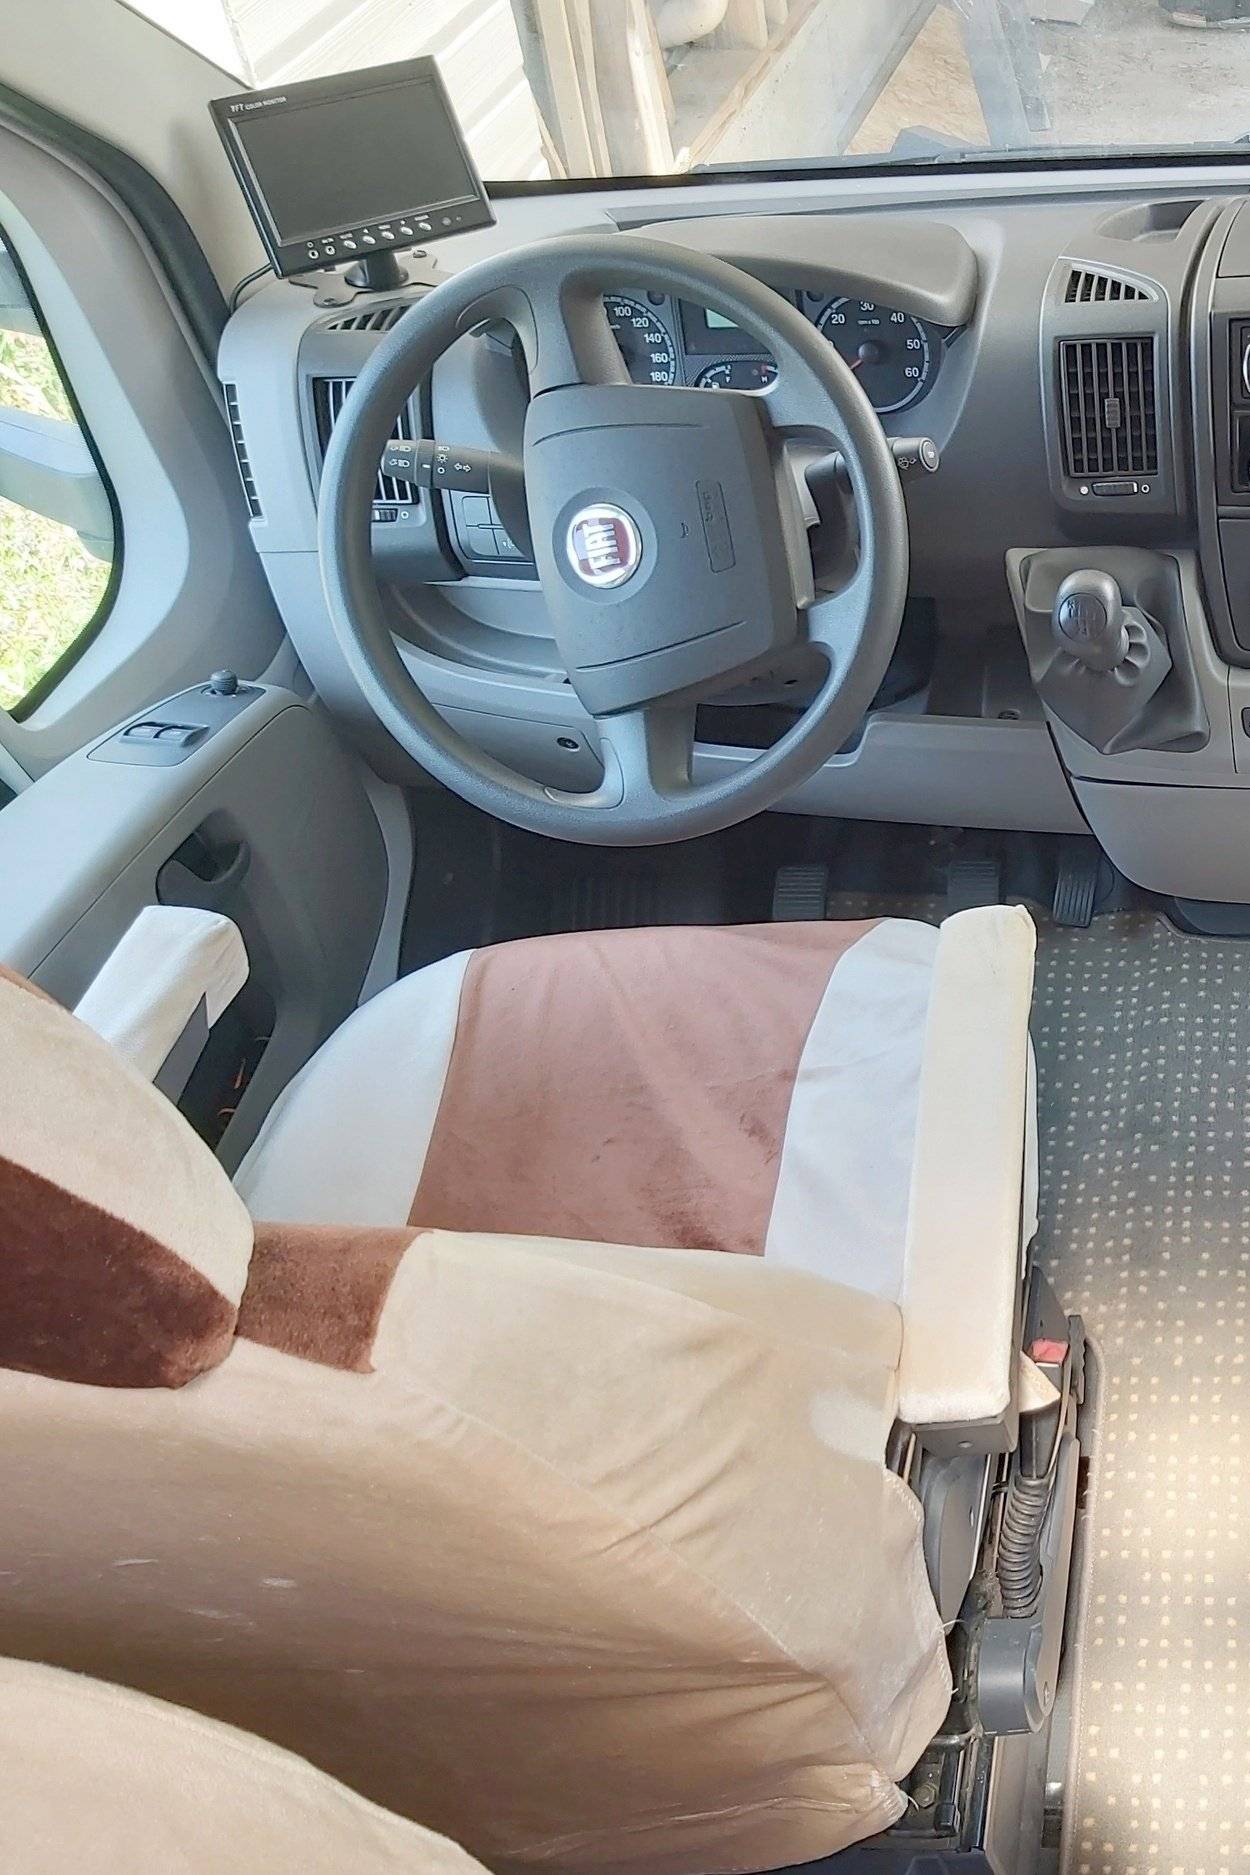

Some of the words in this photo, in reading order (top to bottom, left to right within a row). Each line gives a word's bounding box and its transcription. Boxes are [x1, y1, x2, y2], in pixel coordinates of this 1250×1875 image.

[614, 306, 632, 317] 100
[632, 317, 649, 328] 120
[831, 313, 846, 324] 20
[890, 312, 905, 323] 40
[644, 333, 662, 343] 140
[906, 339, 920, 350] 50
[650, 352, 669, 363] 160
[650, 371, 669, 382] 180
[905, 367, 919, 378] 60
[583, 523, 621, 570] FIAT
